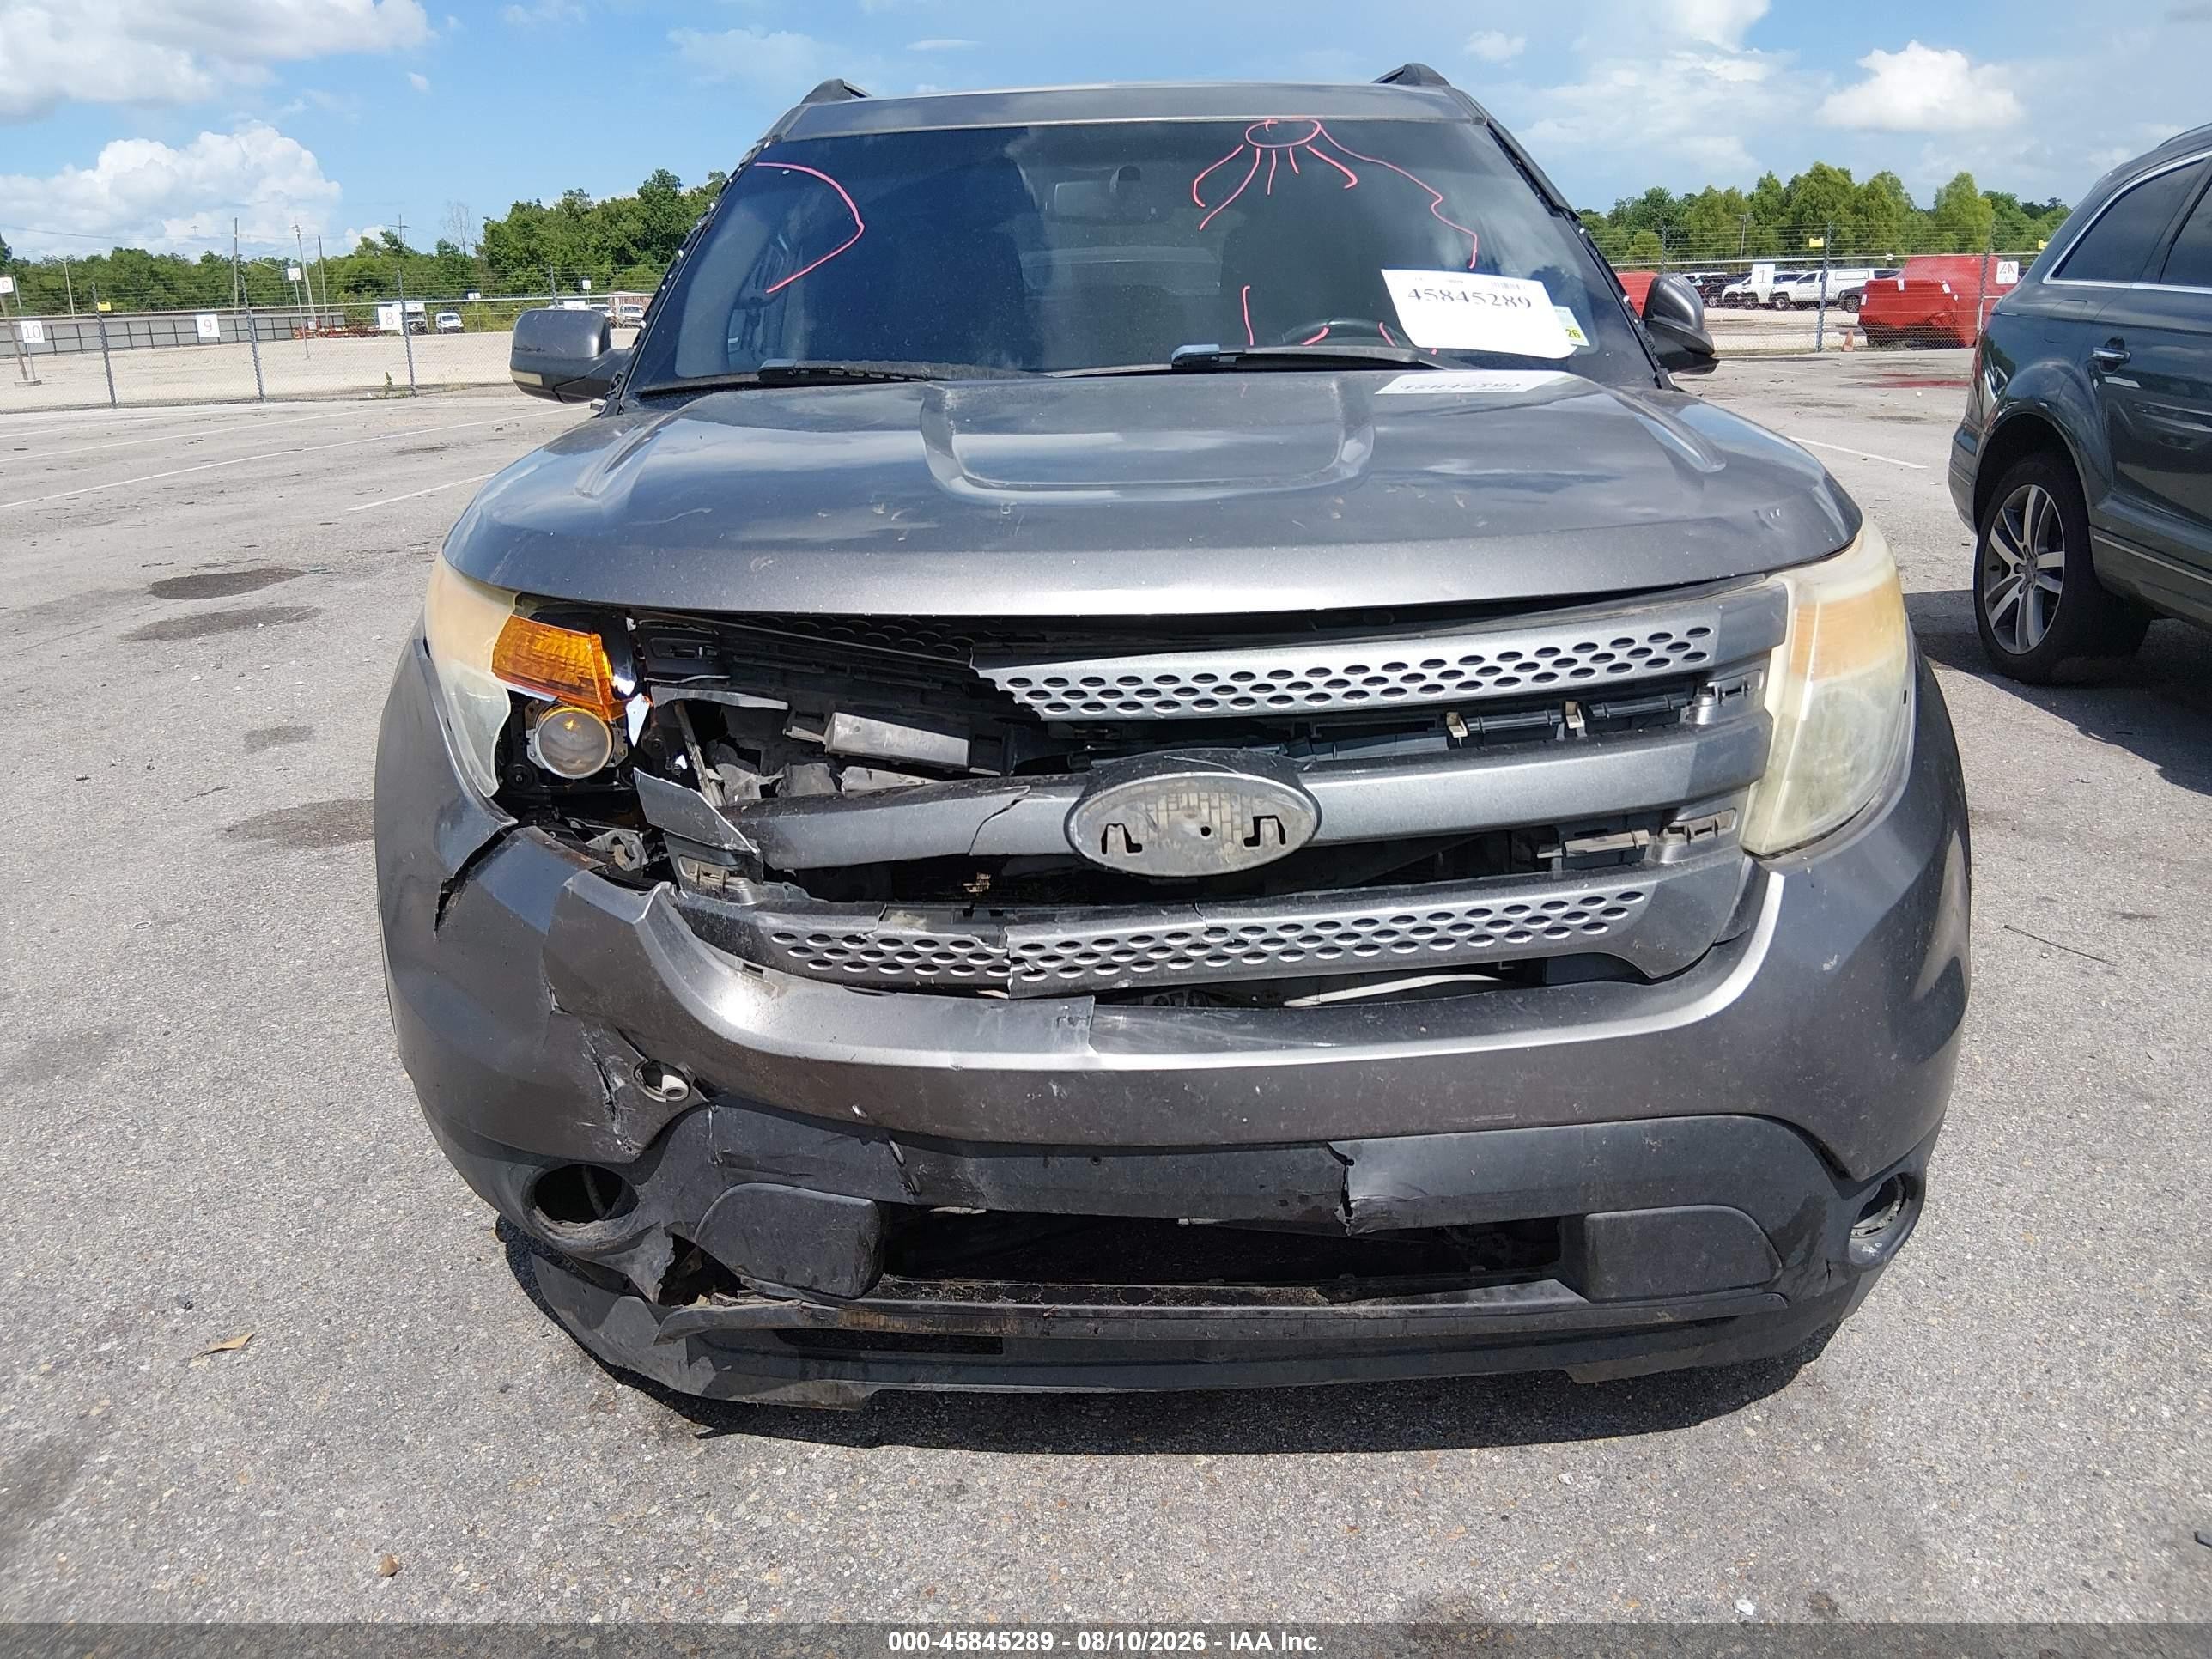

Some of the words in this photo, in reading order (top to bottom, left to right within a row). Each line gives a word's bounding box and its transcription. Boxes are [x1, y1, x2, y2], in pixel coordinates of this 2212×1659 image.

[1759, 270, 1765, 283] 1
[1408, 288, 1532, 308] 45845289
[385, 312, 394, 325] 8
[23, 325, 41, 339] 10
[204, 319, 212, 332] 9
[1565, 328, 1581, 338] 26
